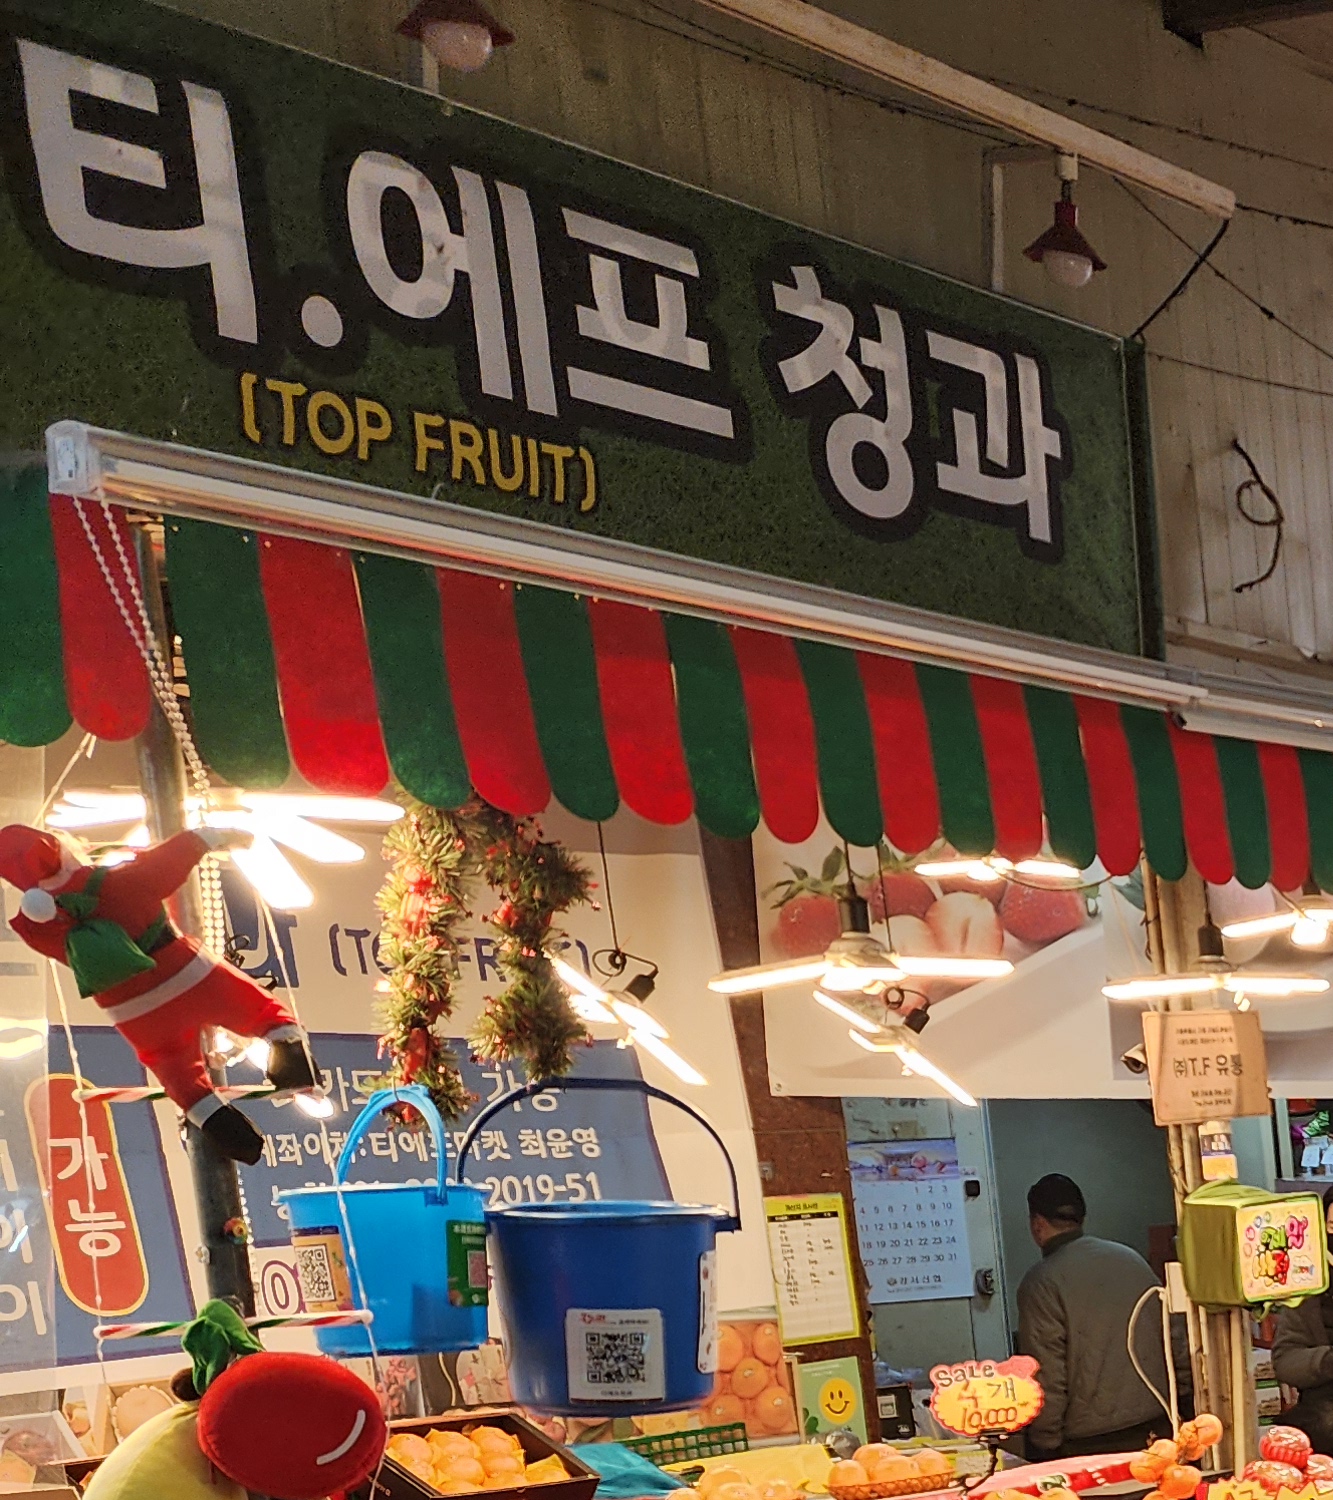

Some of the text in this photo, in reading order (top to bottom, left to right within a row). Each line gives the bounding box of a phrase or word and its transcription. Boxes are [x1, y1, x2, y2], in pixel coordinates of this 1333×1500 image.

[17, 37, 1061, 544] 티.에프 청과
[239, 372, 597, 512] (TOP FRUIT)
